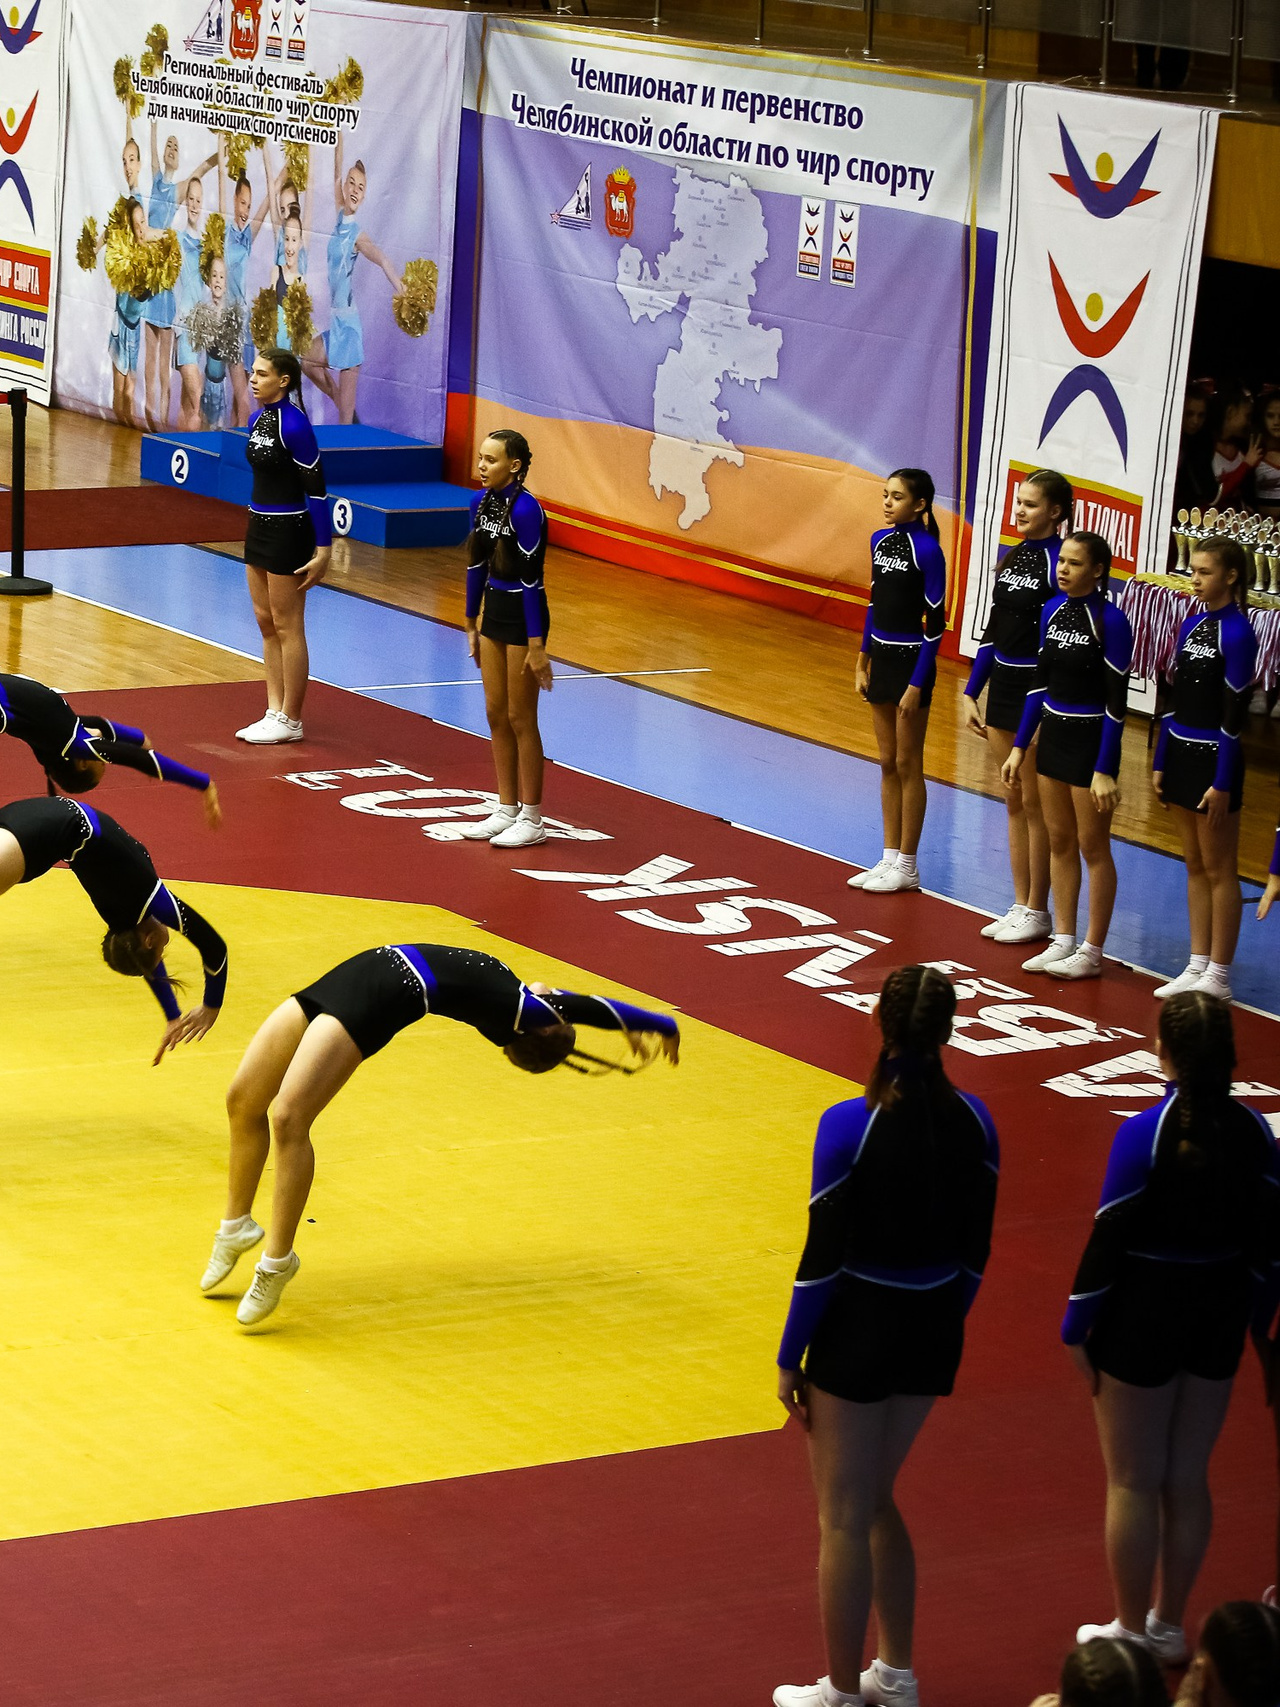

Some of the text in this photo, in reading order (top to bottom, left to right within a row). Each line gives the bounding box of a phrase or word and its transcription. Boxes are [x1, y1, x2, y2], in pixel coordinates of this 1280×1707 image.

[164, 54, 324, 95] Региональный фестиваль
[132, 72, 360, 130] Челябинской области по чир спорту
[571, 57, 863, 130] Чемпионат и первенство
[148, 101, 337, 145] для начинающих спортсменов
[511, 94, 934, 201] Челябинской области по чир спорту
[174, 454, 186, 479] 2
[337, 504, 348, 529] 3
[873, 551, 909, 574] Bagira
[998, 567, 1040, 593] Bagira
[1046, 624, 1090, 650] Bagira
[1182, 638, 1217, 661] Bagira
